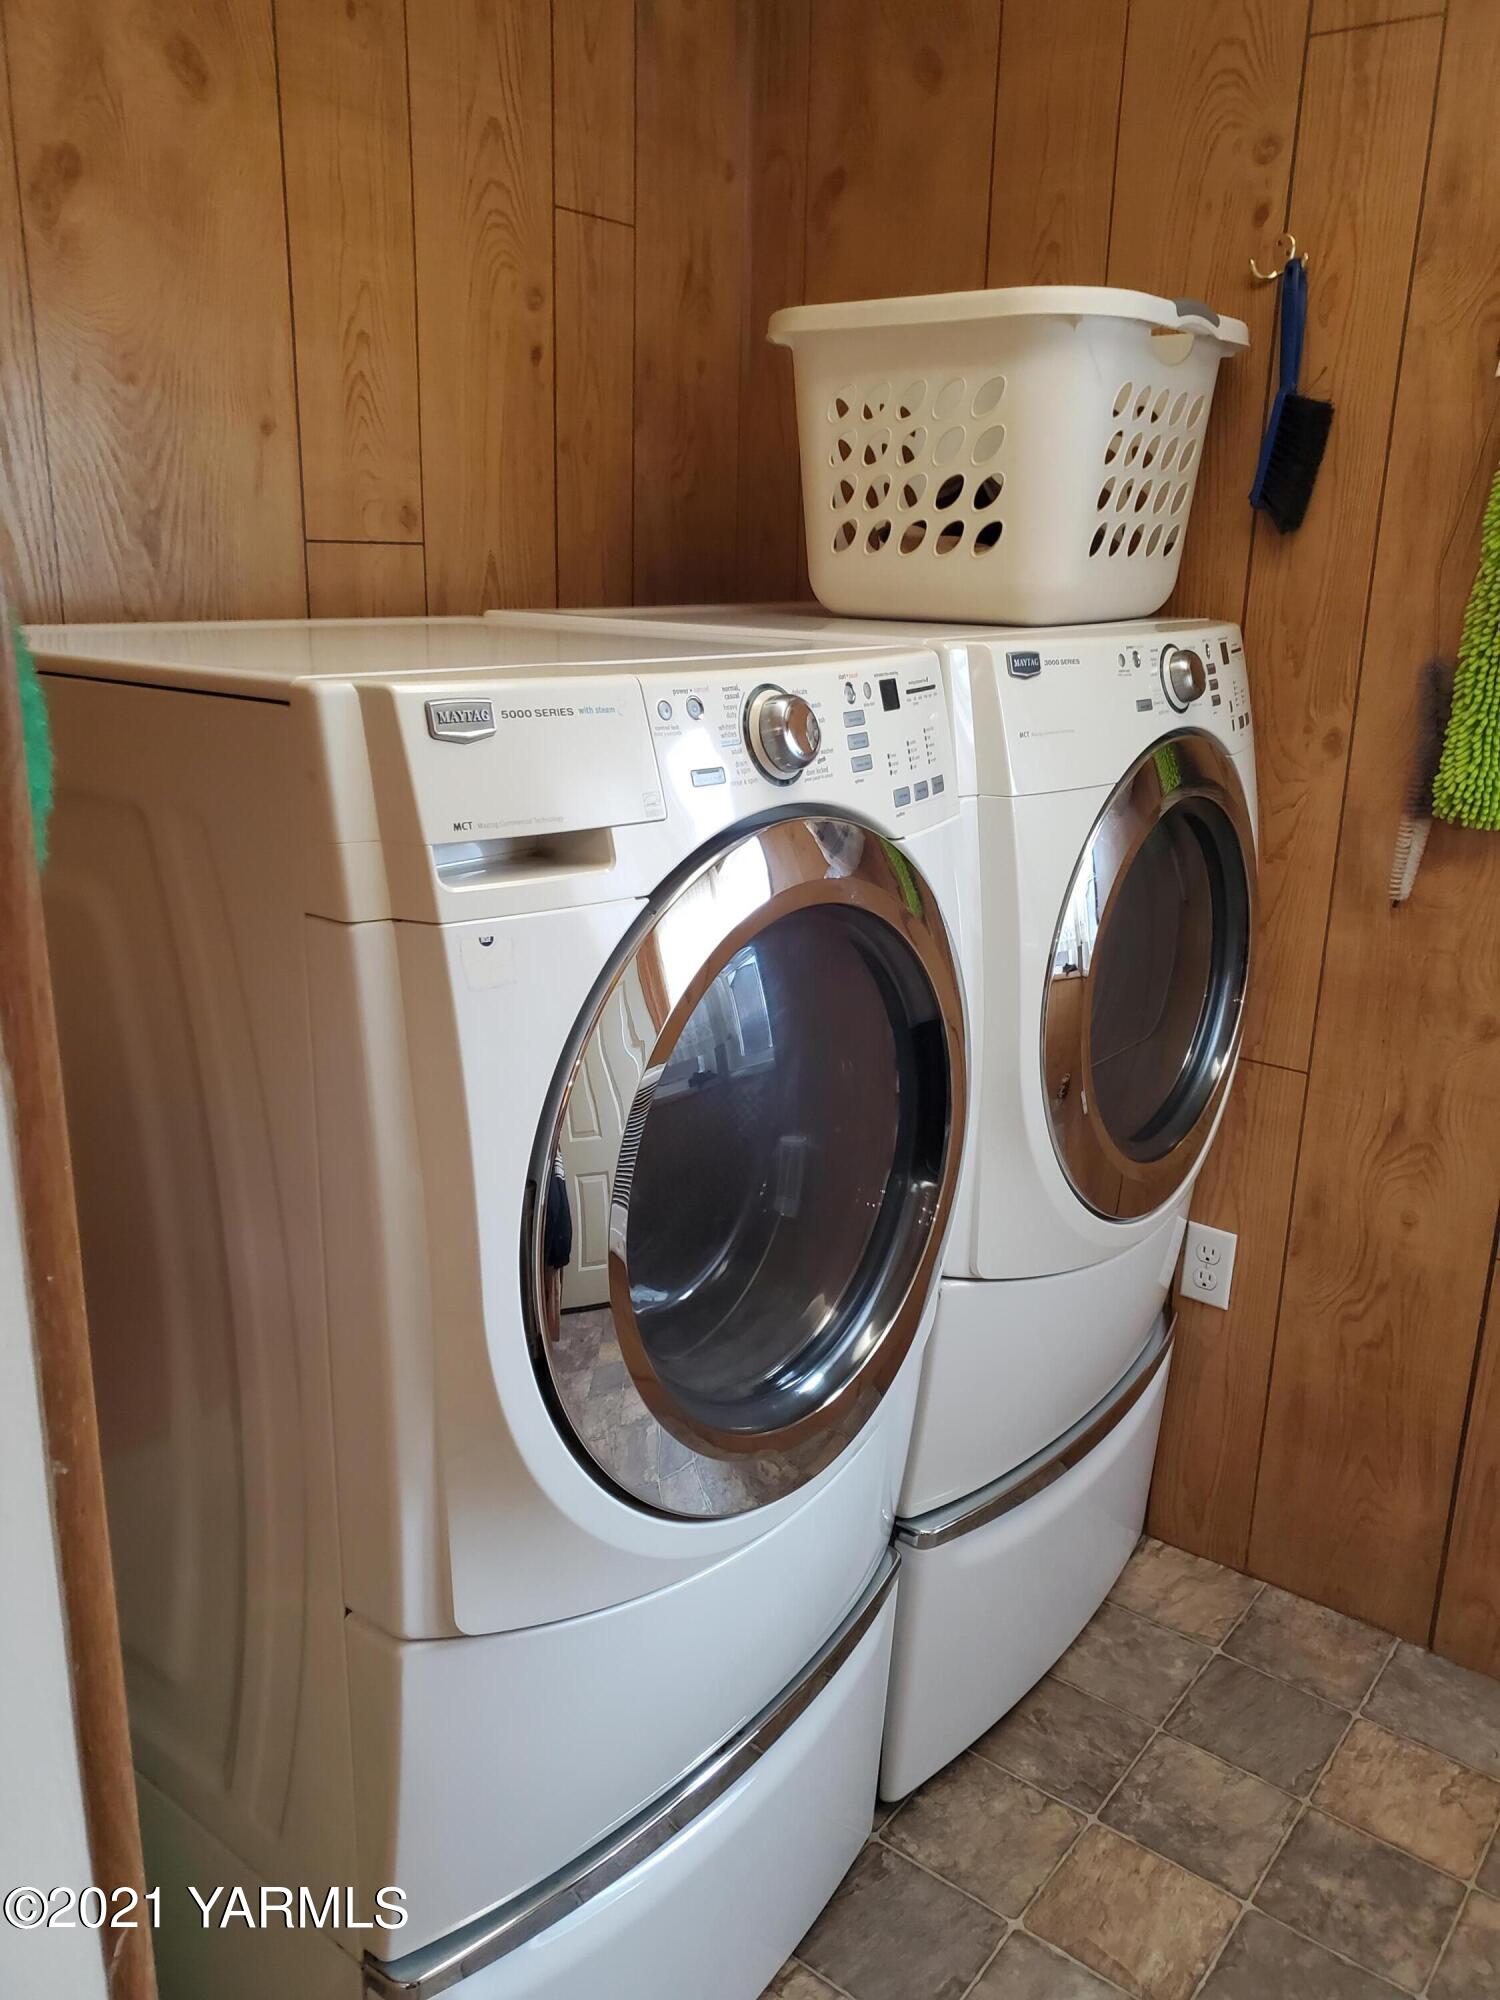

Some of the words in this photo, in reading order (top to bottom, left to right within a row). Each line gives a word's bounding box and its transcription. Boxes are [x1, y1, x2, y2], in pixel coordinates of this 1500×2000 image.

[1013, 658, 1039, 667] MAYTAG
[437, 709, 491, 725] MAYTAG
[501, 709, 532, 719] 5000
[534, 707, 575, 718] SERIES
[453, 821, 473, 832] MCT
